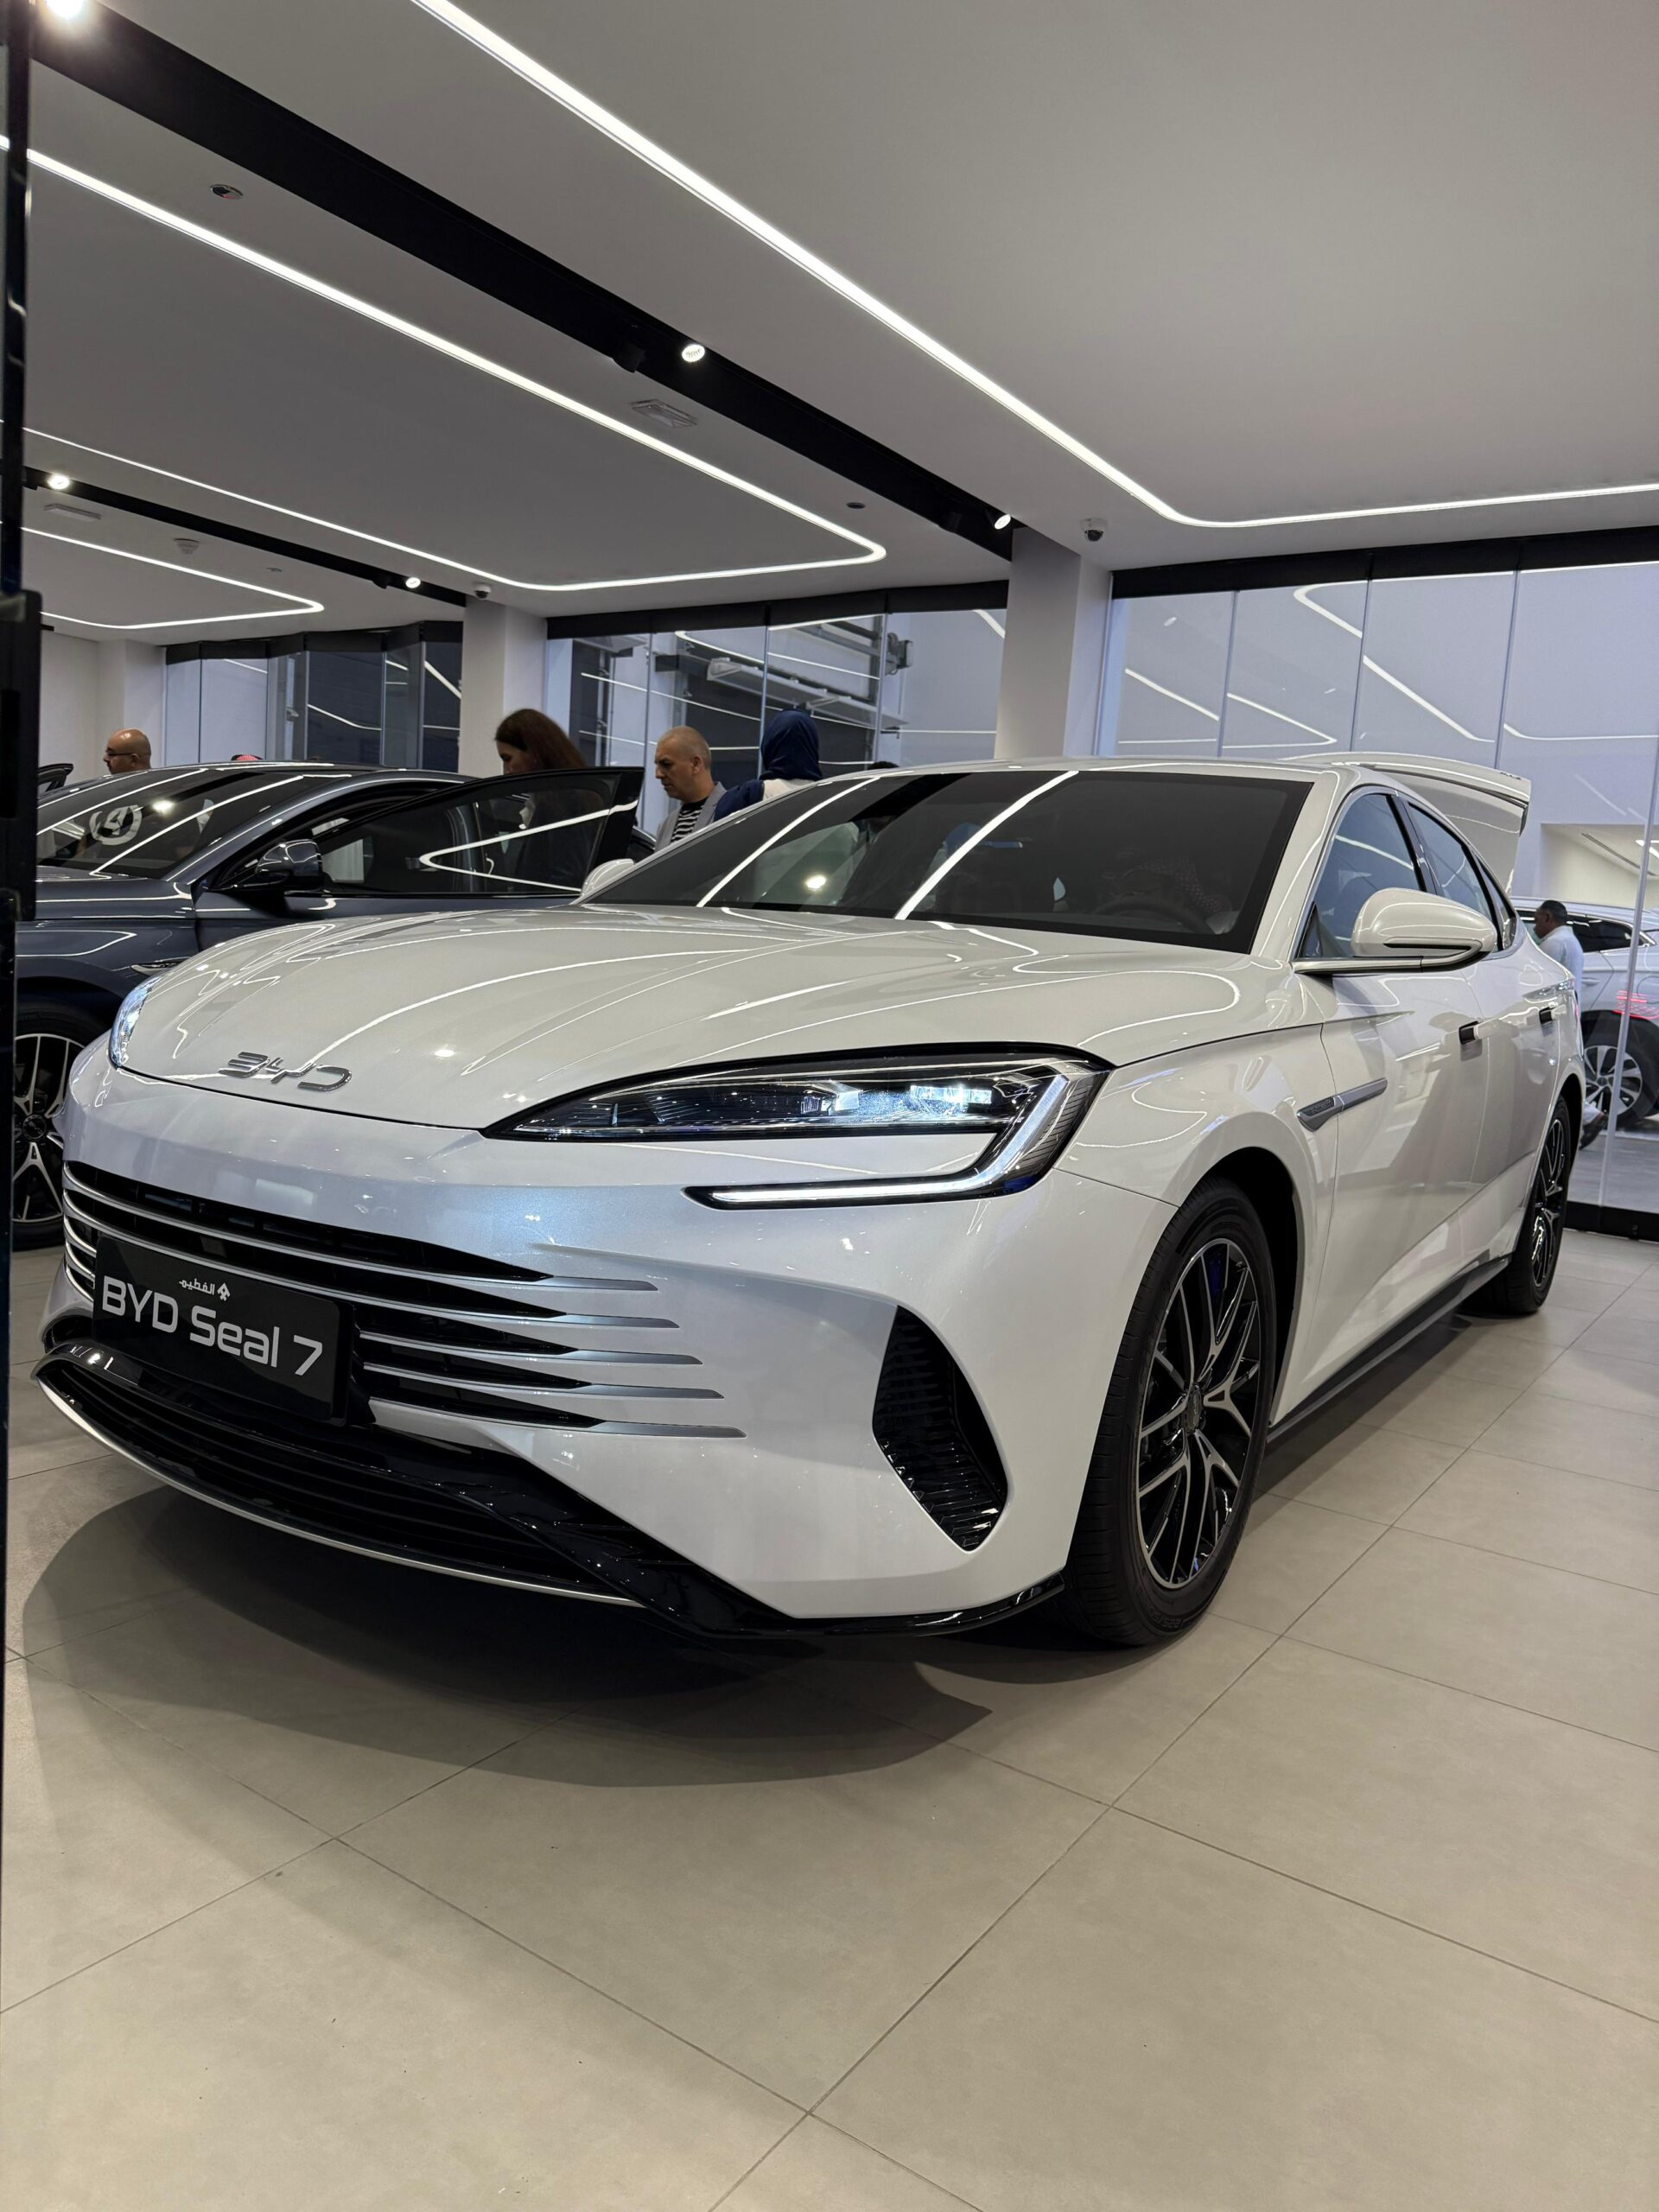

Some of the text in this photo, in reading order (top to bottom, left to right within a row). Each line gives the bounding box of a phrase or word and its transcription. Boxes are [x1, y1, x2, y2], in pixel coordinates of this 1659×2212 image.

[219, 1052, 353, 1092] BYD
[178, 1278, 215, 1295] الفطيم
[102, 1275, 323, 1376] BYD Seal 7
